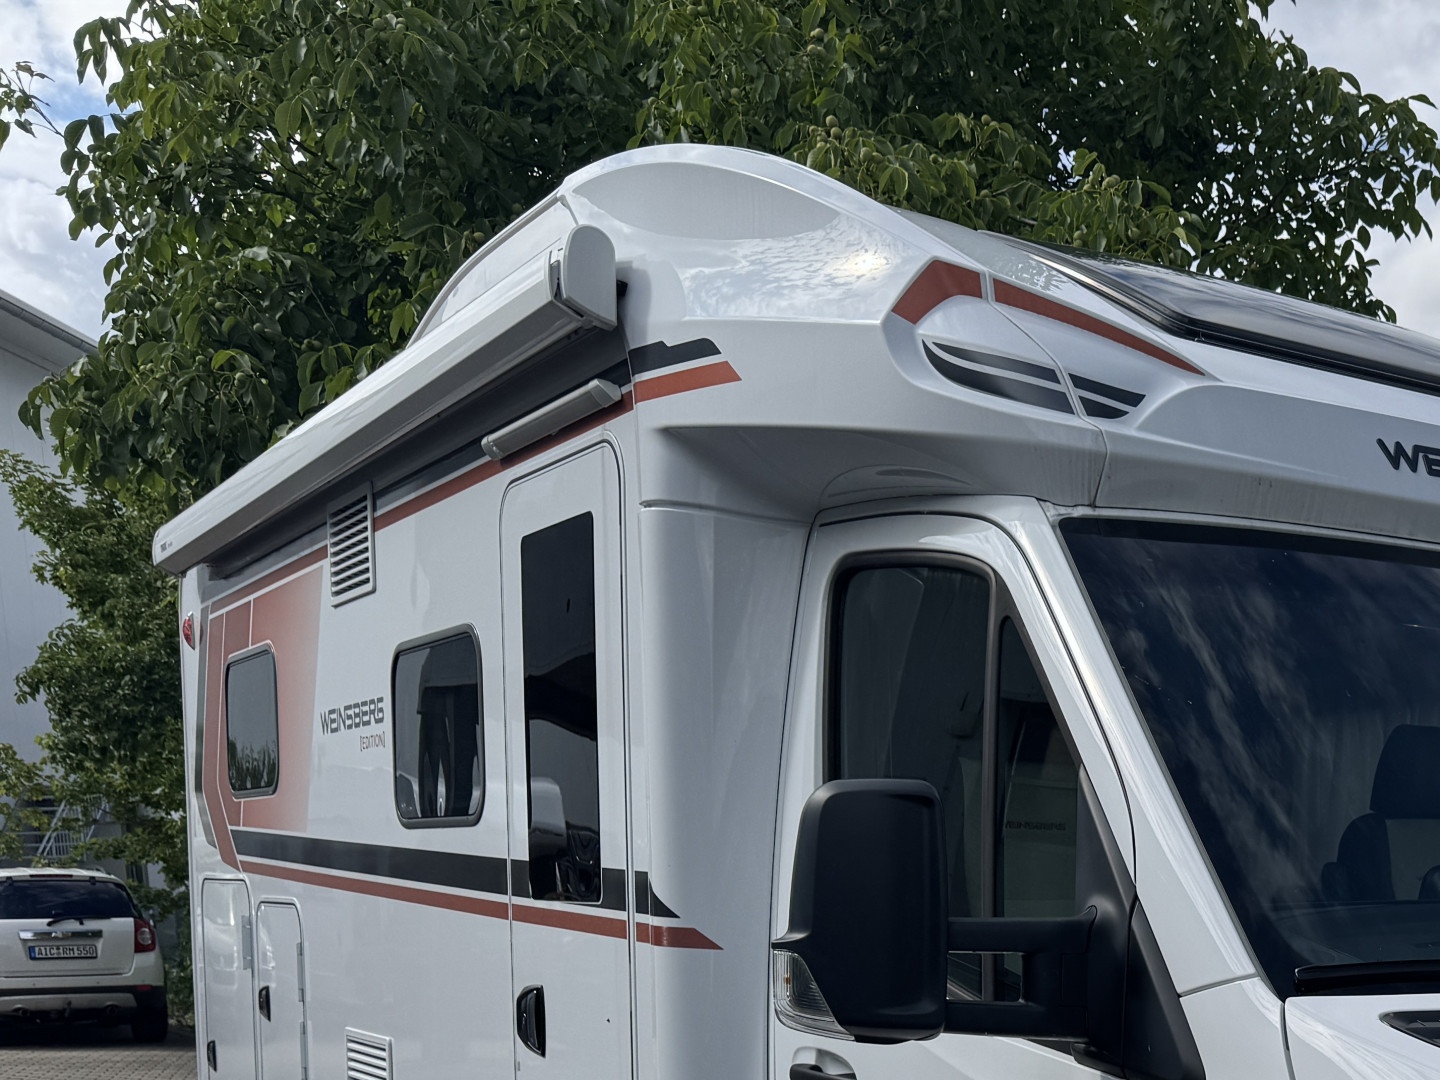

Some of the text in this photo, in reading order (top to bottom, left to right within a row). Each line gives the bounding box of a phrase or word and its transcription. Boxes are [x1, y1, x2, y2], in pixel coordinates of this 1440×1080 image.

[320, 696, 385, 735] WEINSBERG
[37, 946, 95, 957] AIC RM 550
